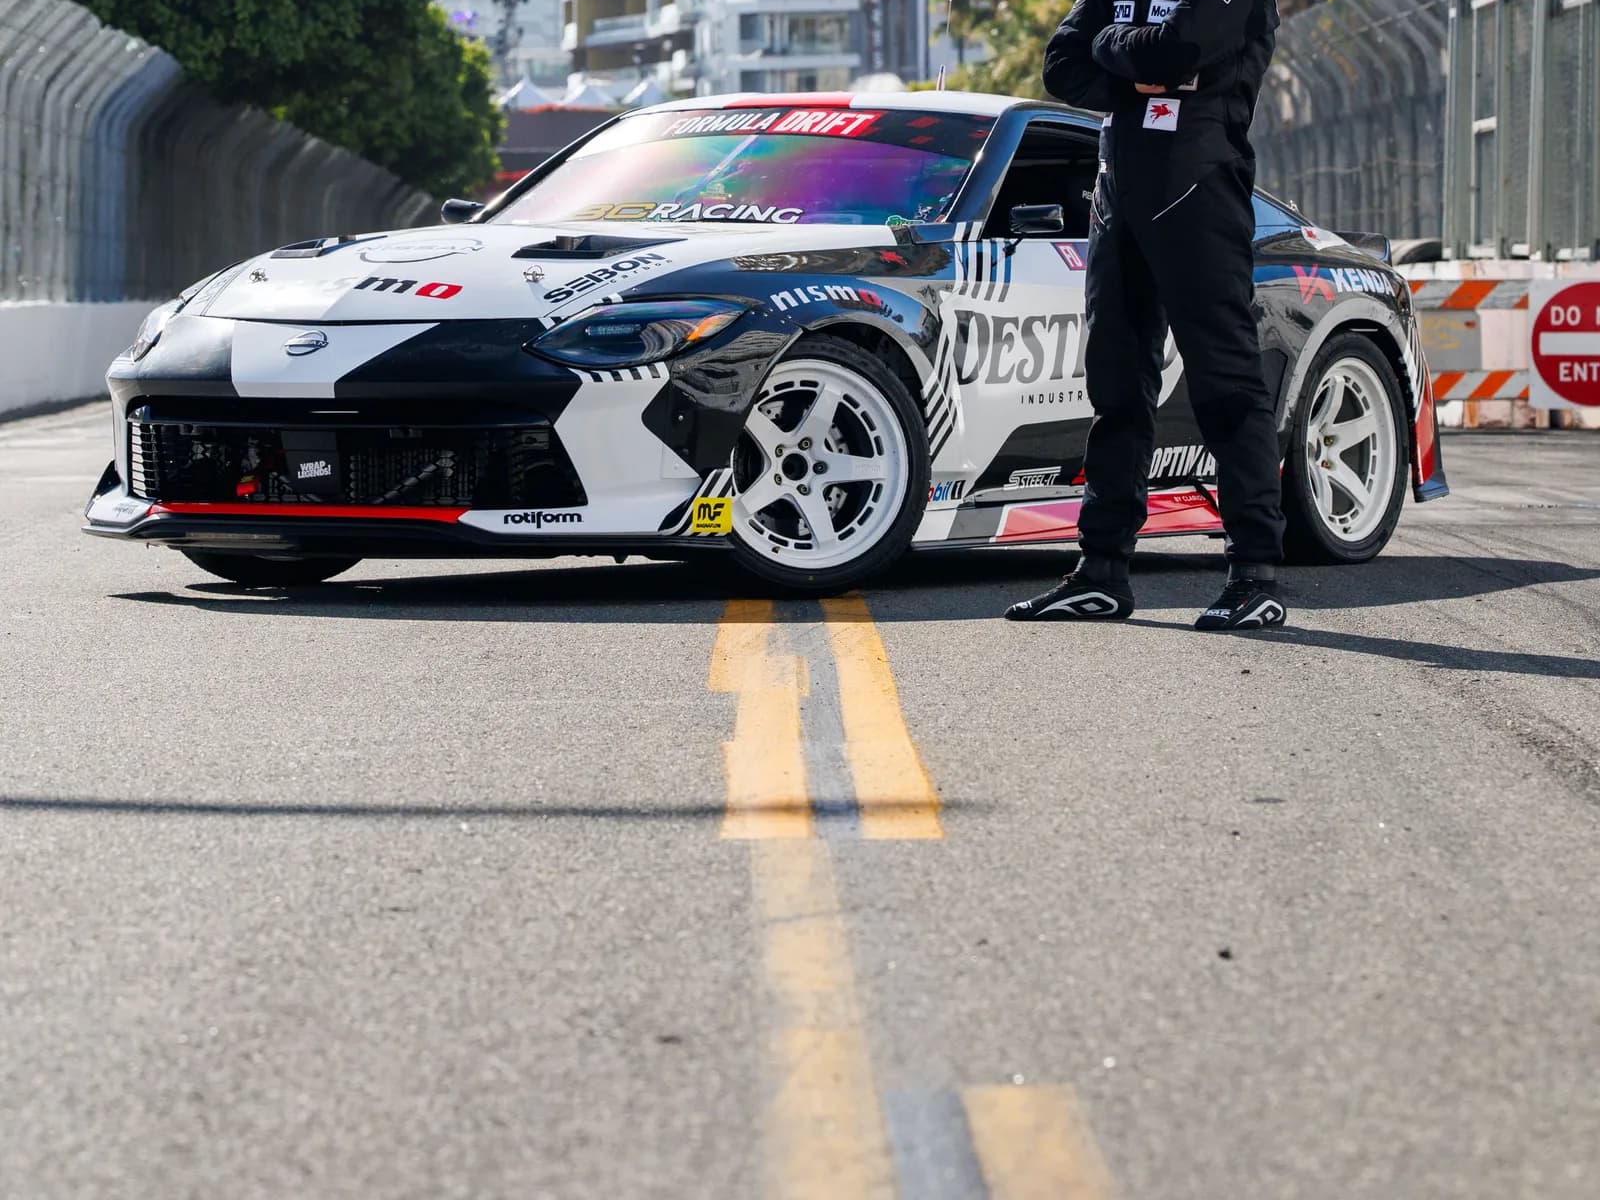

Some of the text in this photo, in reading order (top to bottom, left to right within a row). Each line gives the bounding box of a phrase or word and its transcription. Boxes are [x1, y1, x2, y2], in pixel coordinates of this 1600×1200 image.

[662, 110, 875, 137] FORMULA DRIFT
[543, 253, 666, 303] SEIBON
[1328, 267, 1396, 297] KENDA
[1550, 306, 1581, 326] DO
[953, 309, 1087, 385] DESTI
[1558, 361, 1600, 383] ENT
[1020, 390, 1090, 405] INDUSTR
[299, 460, 327, 471] WRAP
[1147, 444, 1217, 480] OPTIMA
[928, 481, 952, 503] obil
[503, 511, 583, 529] rotiform
[697, 502, 725, 521] MF
